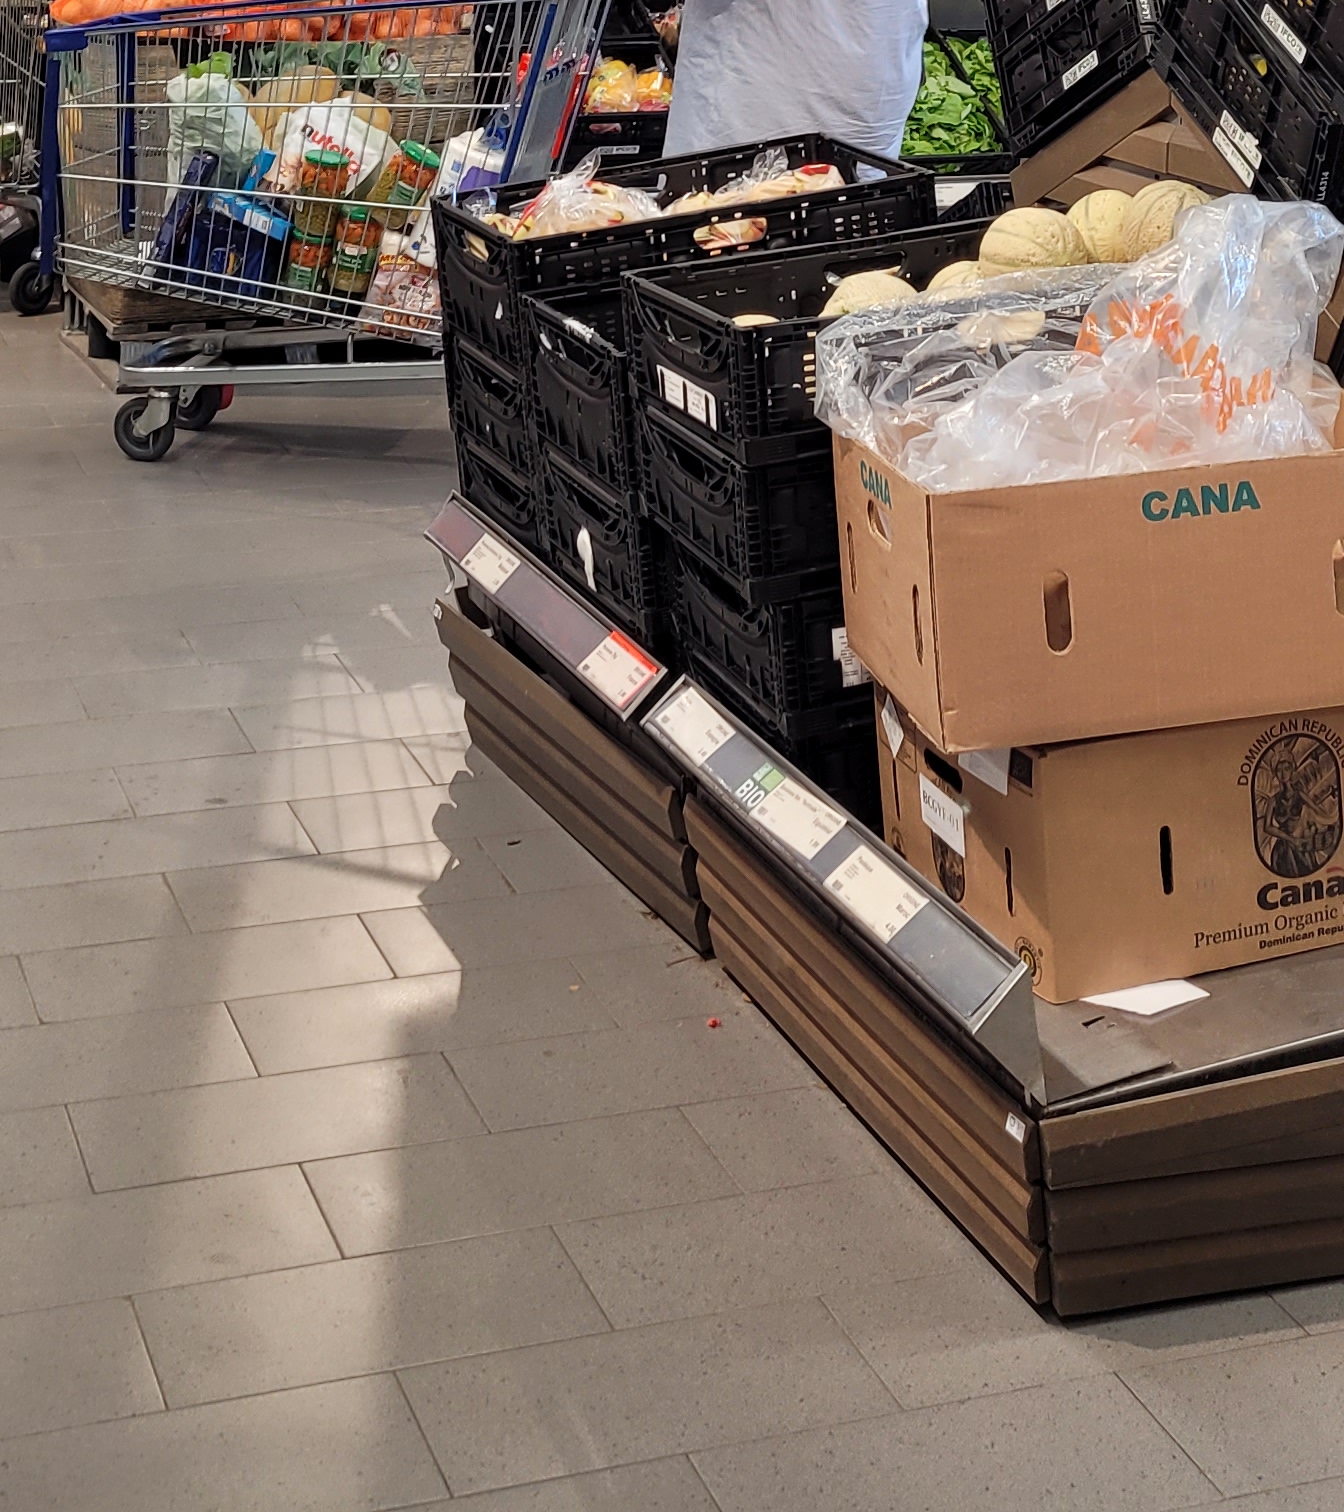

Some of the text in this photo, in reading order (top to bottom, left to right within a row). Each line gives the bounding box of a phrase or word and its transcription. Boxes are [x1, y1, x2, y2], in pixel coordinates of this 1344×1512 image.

[1278, 24, 1297, 48] IFCO
[860, 459, 893, 510] CANA
[1141, 479, 1262, 523] CANA
[1237, 718, 1298, 786] DOMINICAN
[734, 778, 766, 809] BIO
[1194, 919, 1269, 949] Premium
[1274, 904, 1339, 931] Organic
[1258, 929, 1315, 950] Dominican
